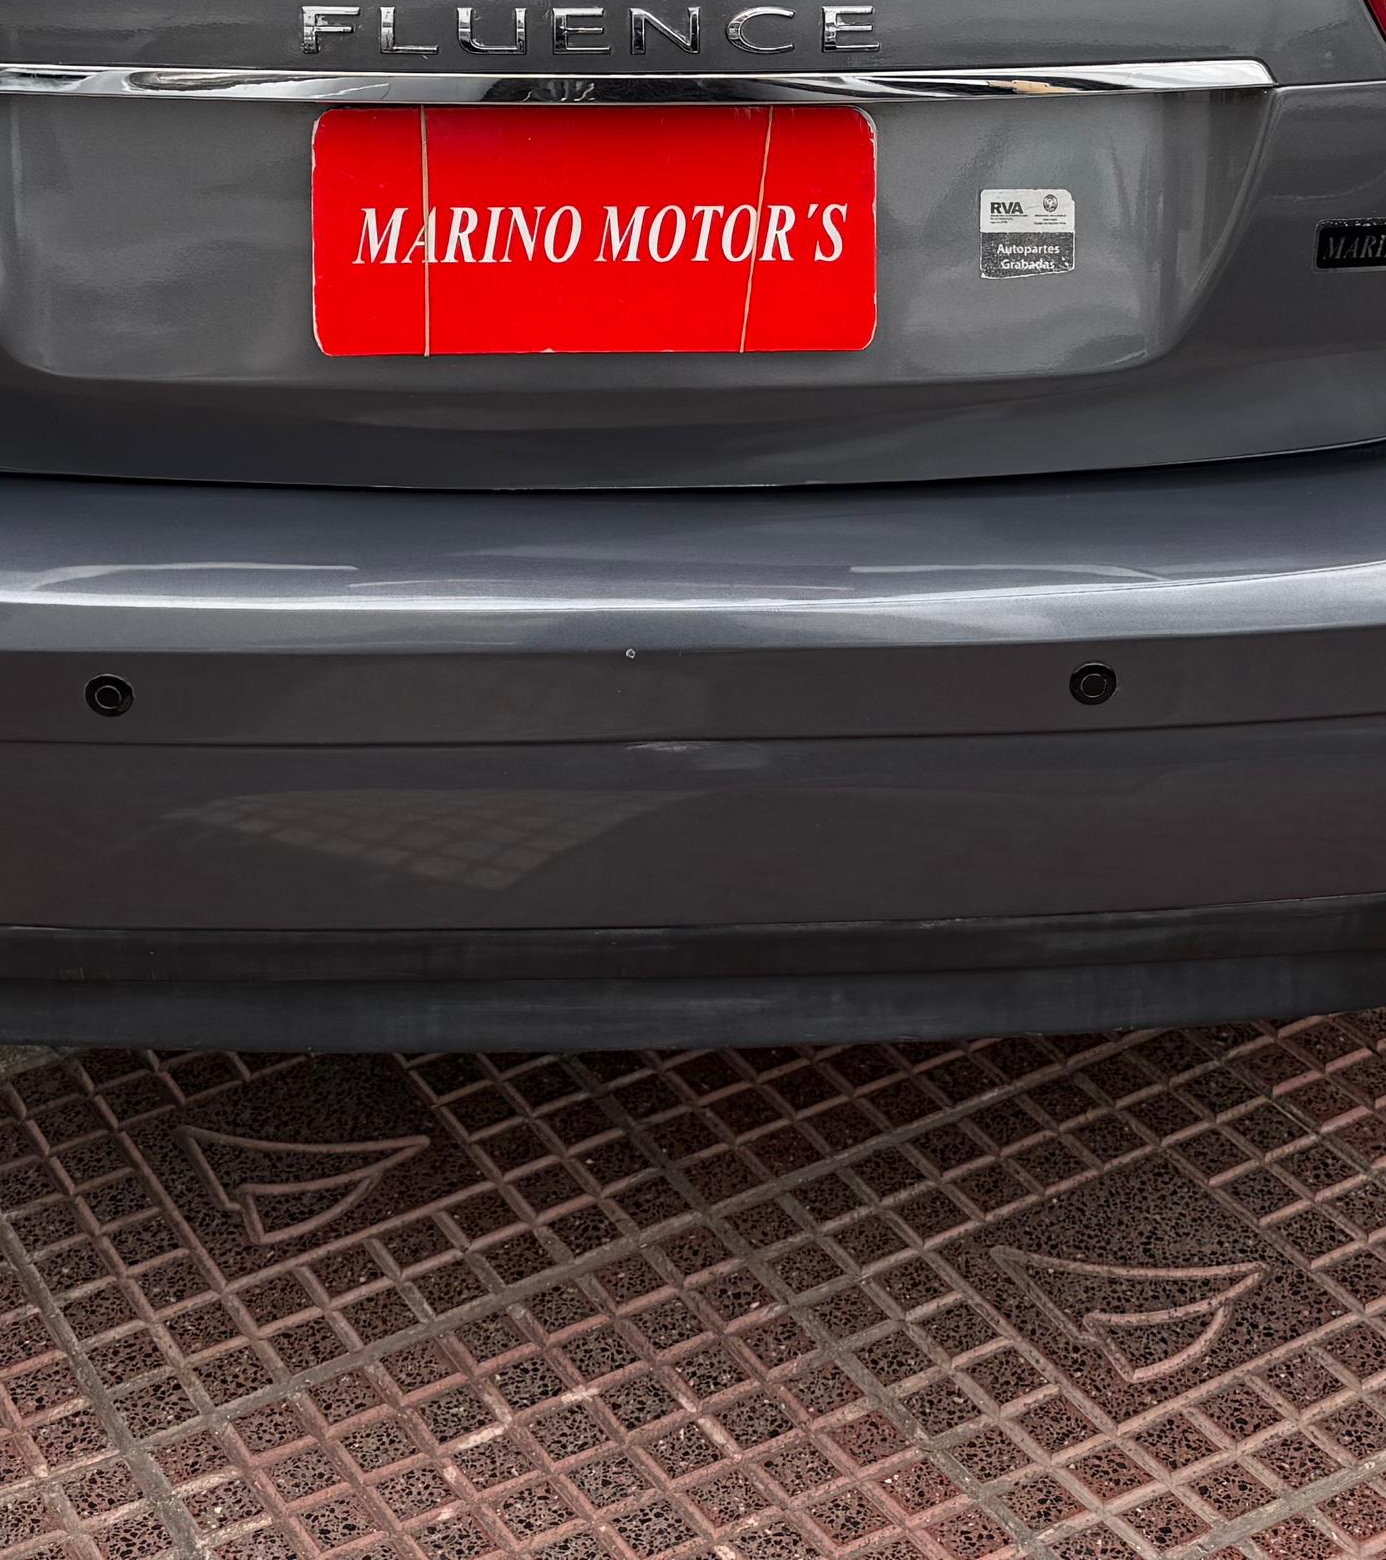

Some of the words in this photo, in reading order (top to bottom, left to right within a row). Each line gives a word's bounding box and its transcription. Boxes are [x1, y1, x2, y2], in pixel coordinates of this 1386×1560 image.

[301, 5, 882, 55] FLUENCE
[990, 201, 1024, 214] RVA
[351, 204, 583, 265] MARINO
[996, 243, 1061, 256] Autopartes
[1000, 257, 1055, 270] Grabadas
